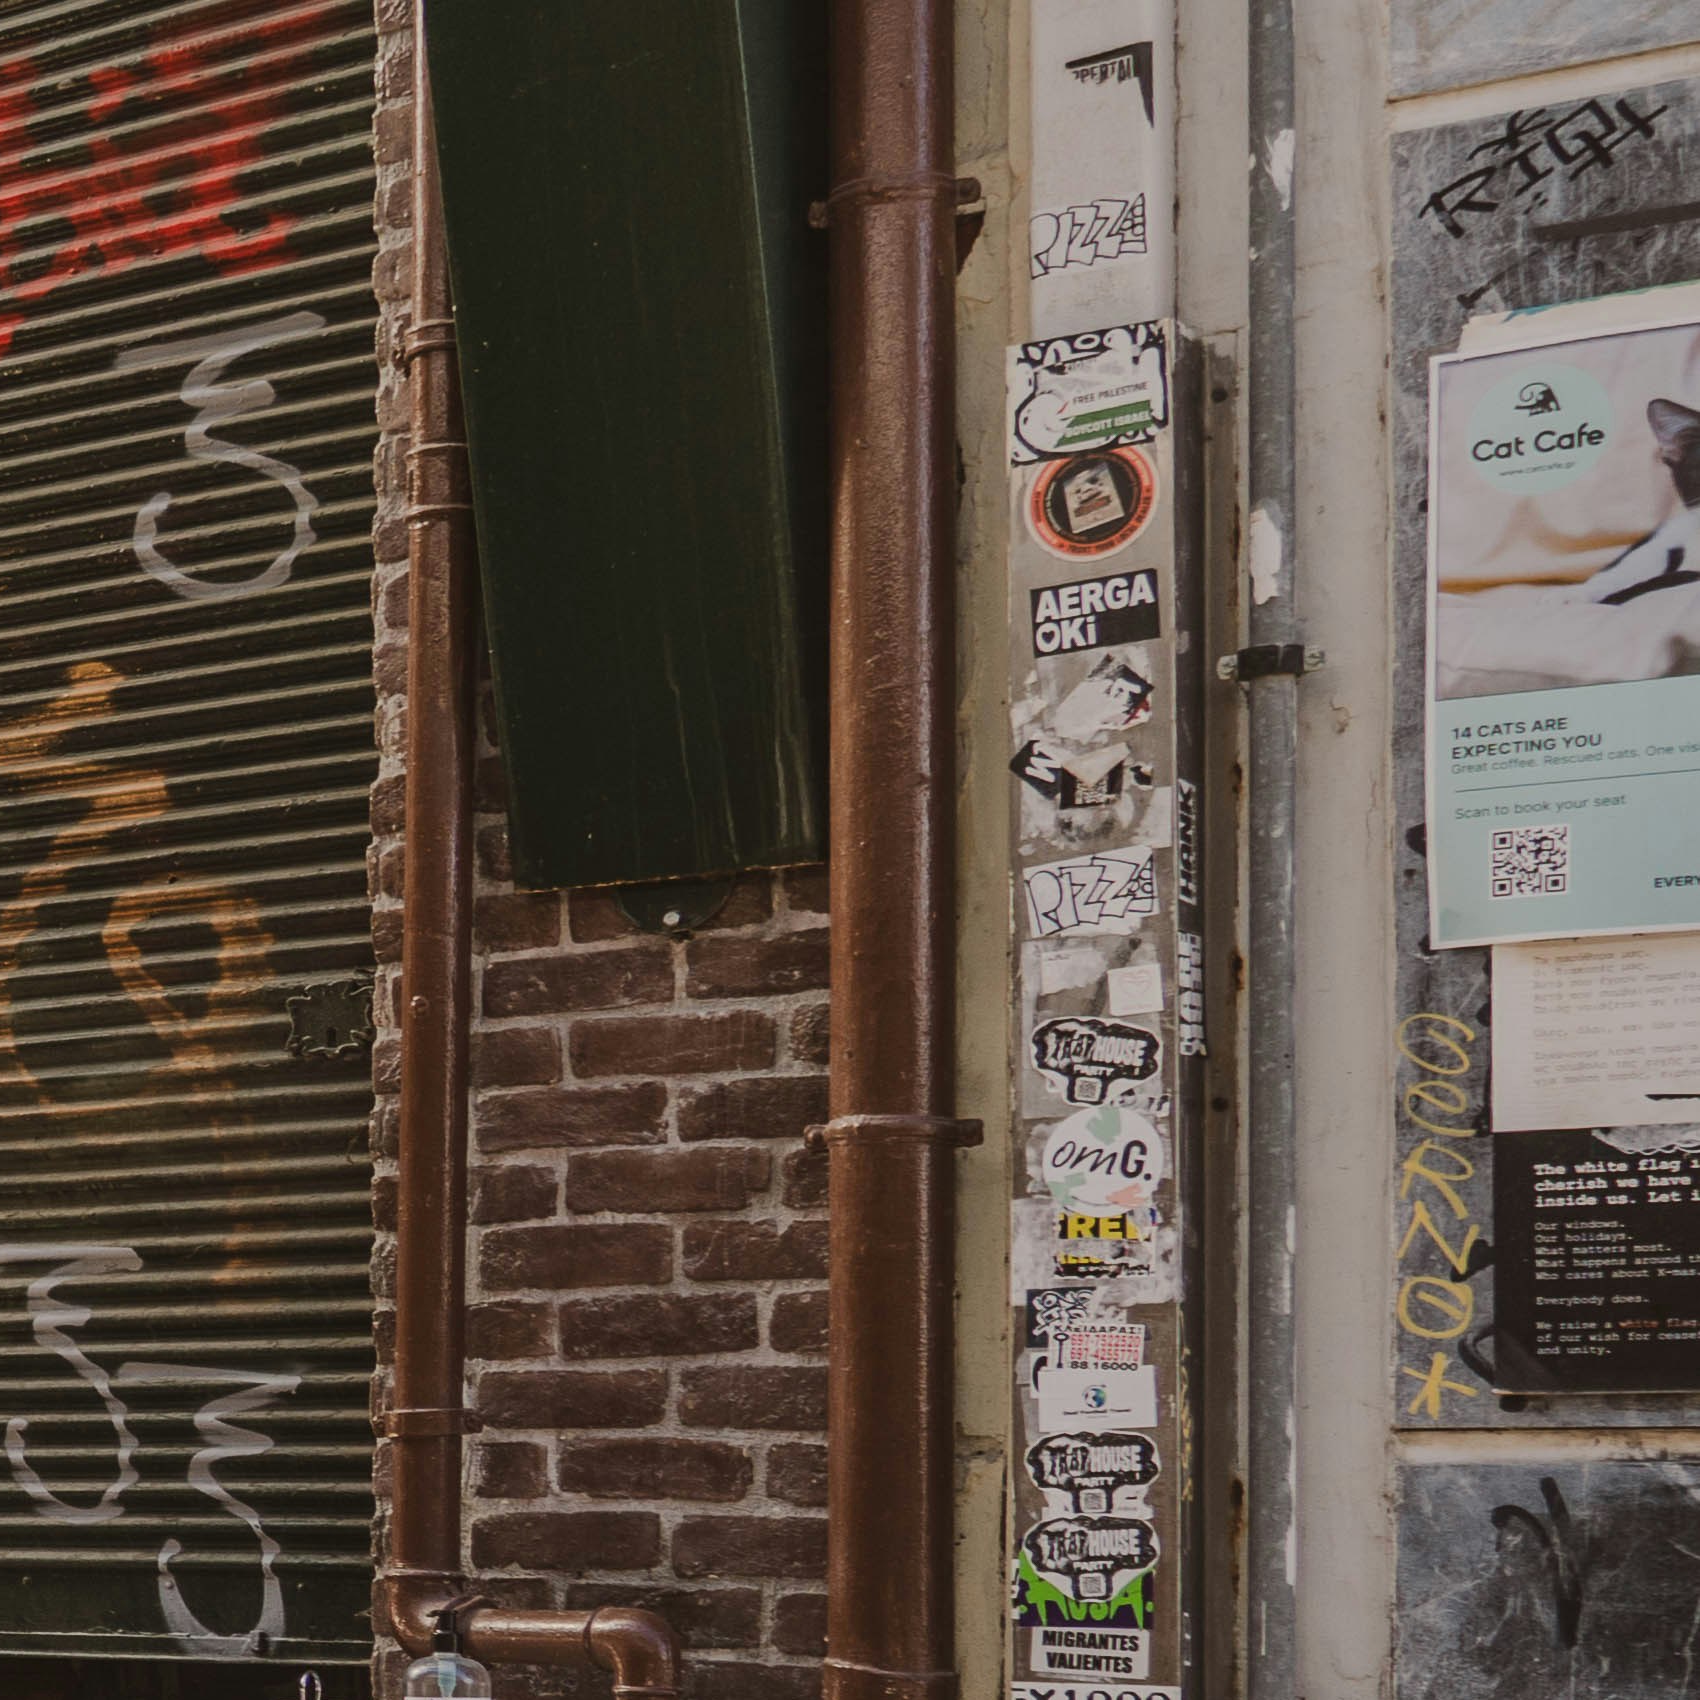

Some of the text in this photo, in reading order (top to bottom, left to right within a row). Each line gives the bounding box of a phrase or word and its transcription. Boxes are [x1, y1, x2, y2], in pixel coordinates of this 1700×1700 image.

[1073, 381, 1149, 406] FREE PALESTINE
[1112, 410, 1152, 428] ISRAEL
[1471, 422, 1605, 462] Cat Cafe
[1036, 573, 1155, 624] AERGA
[1452, 717, 1568, 740] 14 CATS ARE
[1451, 733, 1602, 760] EXPECTING YOU
[1451, 762, 1489, 775] Great
[1543, 752, 1604, 766] Rescued
[1455, 794, 1627, 821] Scan to book your seat
[1094, 1036, 1147, 1066] HOUSE
[1534, 1163, 1566, 1176] The
[1574, 1160, 1629, 1174] white
[1637, 1158, 1681, 1173] flag
[1534, 1175, 1692, 1193] cherish we have
[1535, 1194, 1598, 1208] inside
[1605, 1194, 1637, 1205] us.
[1647, 1191, 1682, 1203] Let
[1534, 1222, 1558, 1231] Our
[1534, 1234, 1558, 1243] Our
[1089, 1445, 1141, 1472] HOUSE
[1088, 1529, 1141, 1556] HOUSE
[1042, 1630, 1140, 1652] MIGRANTES
[1046, 1652, 1134, 1674] VALIENTES
